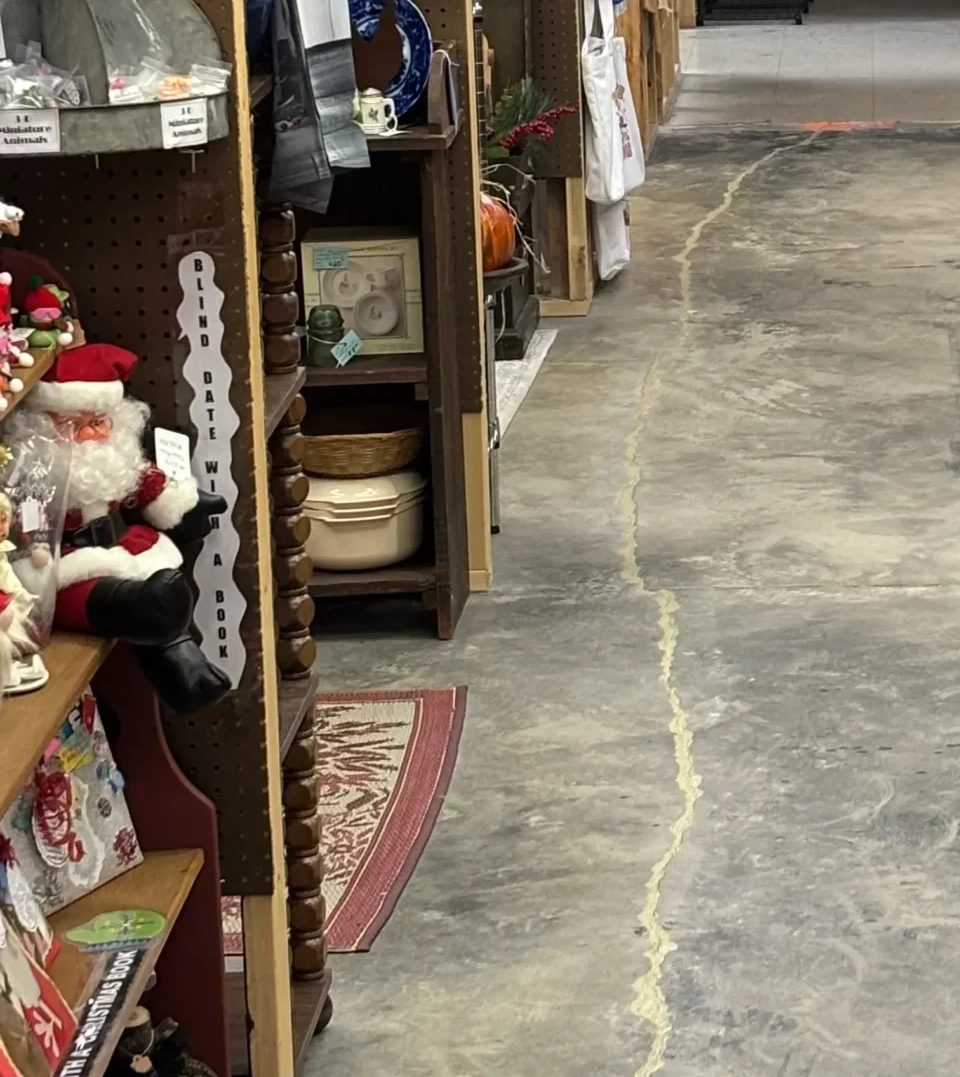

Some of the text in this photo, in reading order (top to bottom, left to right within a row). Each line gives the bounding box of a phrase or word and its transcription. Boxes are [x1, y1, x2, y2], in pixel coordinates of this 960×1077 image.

[193, 258, 229, 659] BLIND DATE WIH A BOOK
[105, 949, 139, 981] BOOK
